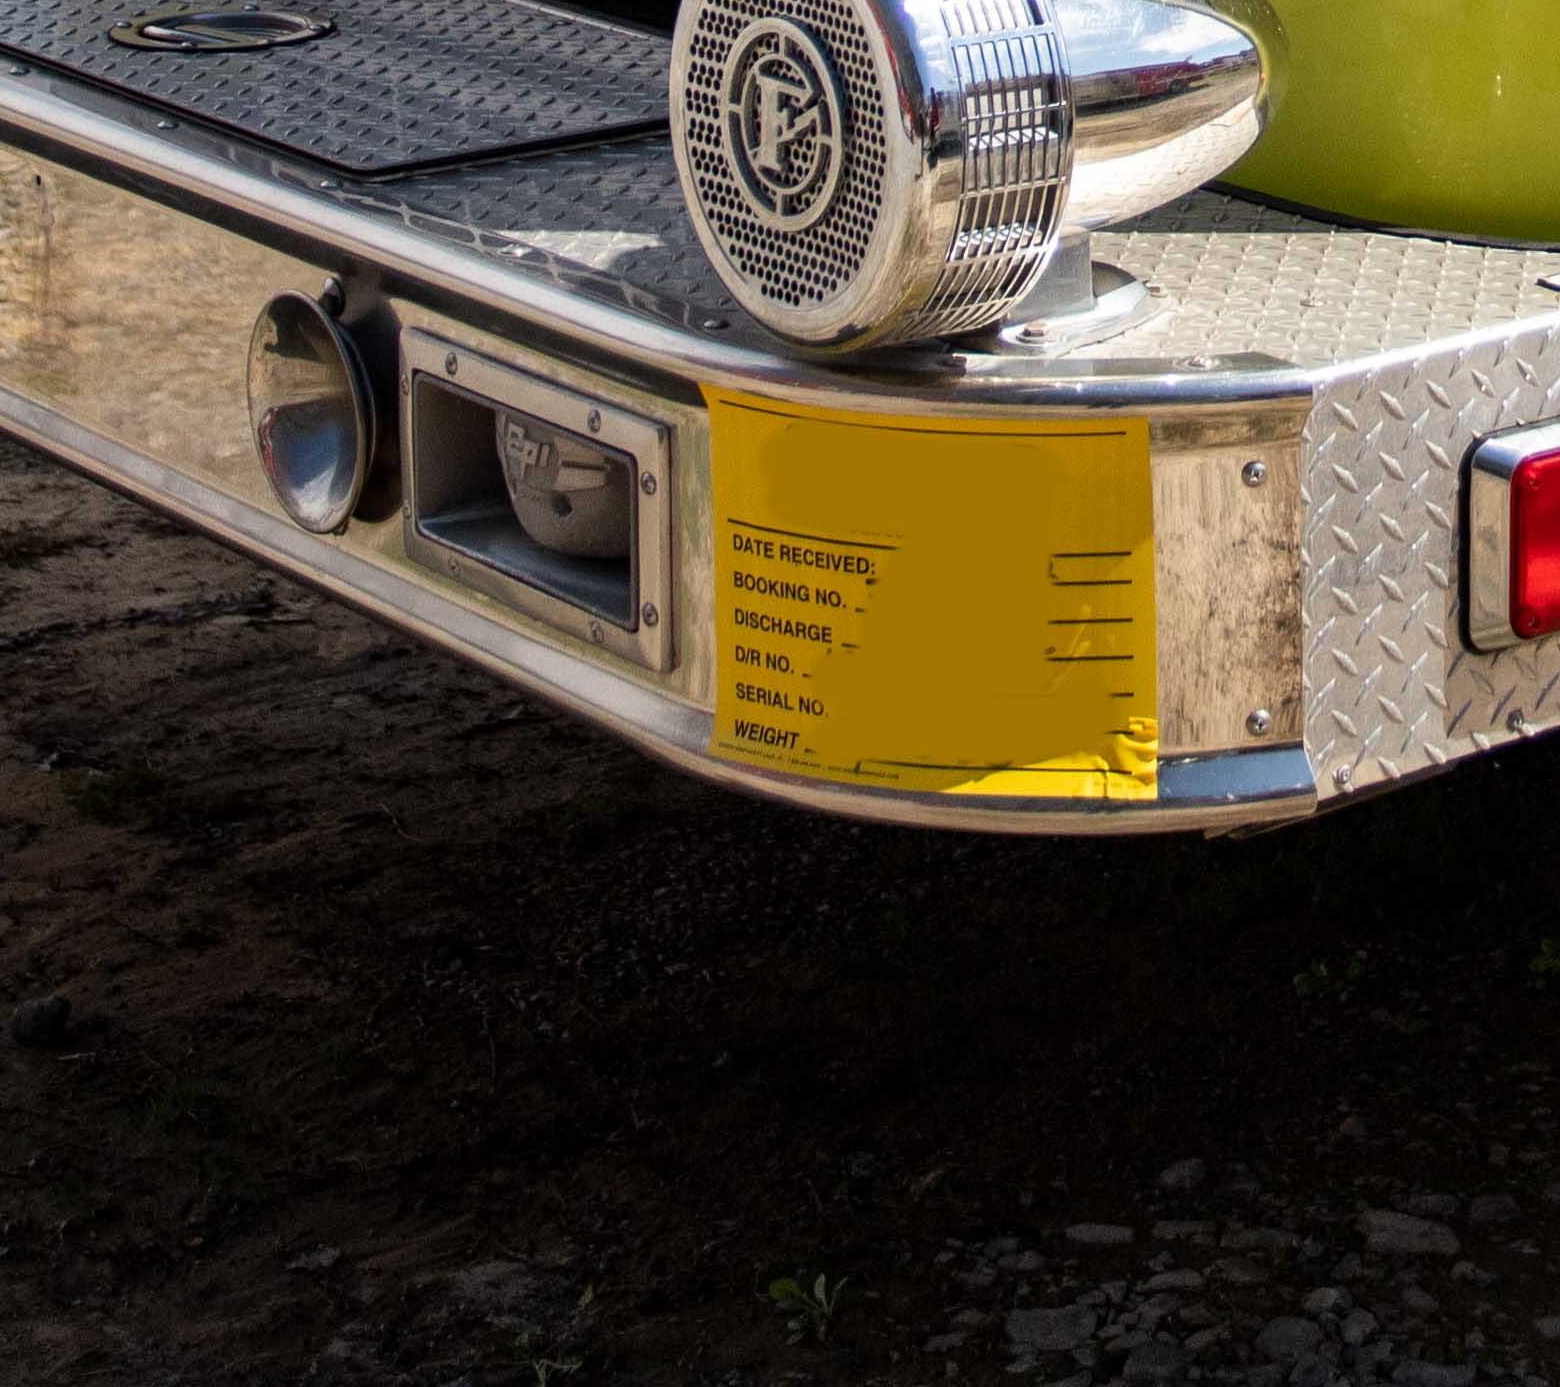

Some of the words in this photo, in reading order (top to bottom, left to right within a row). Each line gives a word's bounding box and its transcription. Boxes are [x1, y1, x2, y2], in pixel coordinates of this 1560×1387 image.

[733, 534, 774, 559] DATE
[779, 545, 876, 575] RECEIVED:
[733, 571, 810, 603] BOOKING
[815, 588, 847, 609] NO.
[734, 608, 833, 643] DISCHARGE
[735, 645, 761, 667] D/R
[766, 652, 795, 674] NO.
[736, 683, 794, 711] SERIAL
[798, 696, 830, 718] NO.
[734, 719, 800, 750] WEIGHT
